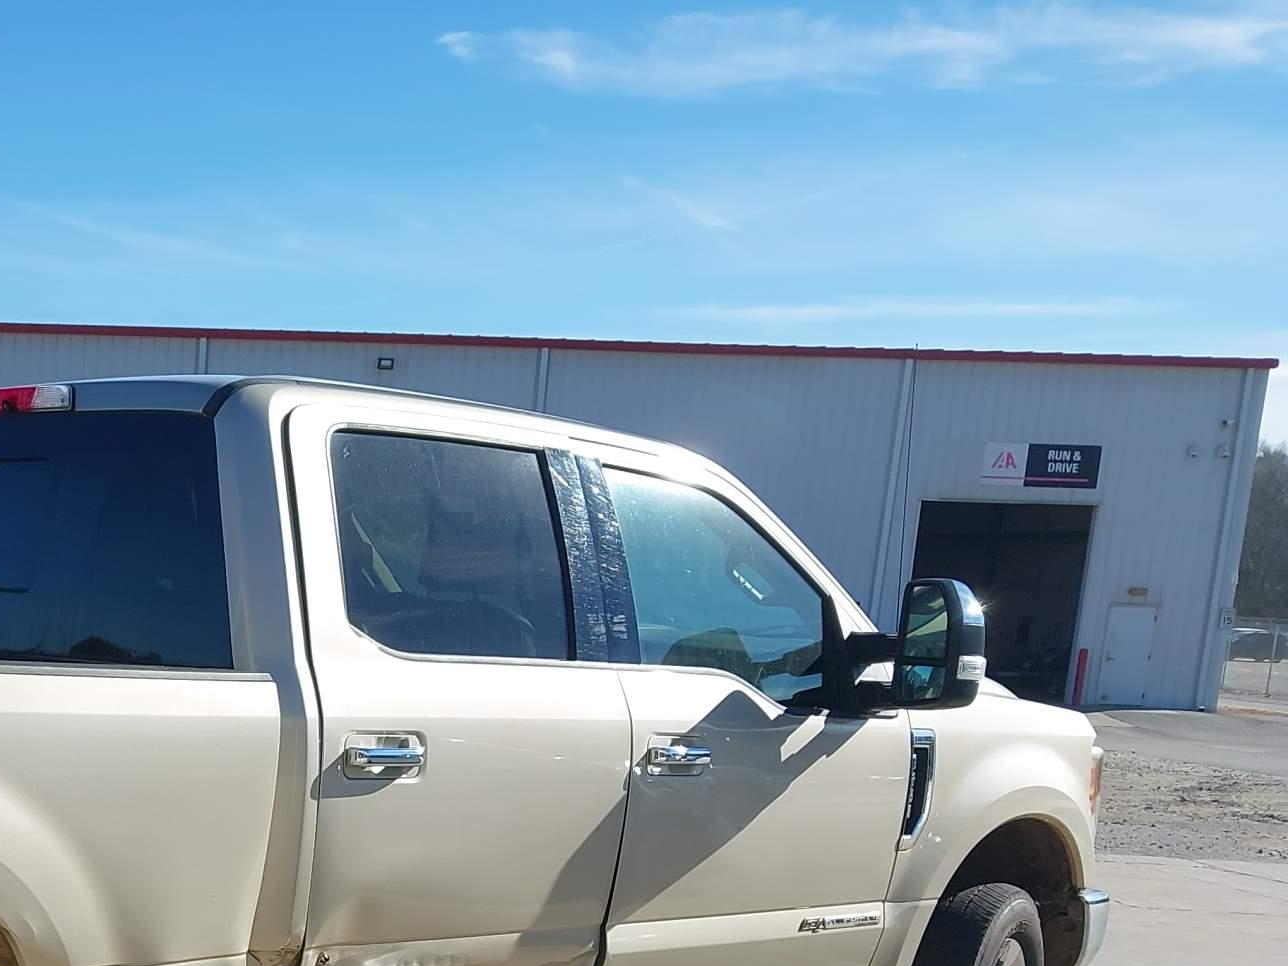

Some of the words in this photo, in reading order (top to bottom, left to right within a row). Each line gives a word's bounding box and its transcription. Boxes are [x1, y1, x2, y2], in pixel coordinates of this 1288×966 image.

[1048, 450, 1070, 461] RUN
[1073, 450, 1081, 461] &
[1047, 462, 1079, 473] DRIVE
[1224, 616, 1232, 625] 15
